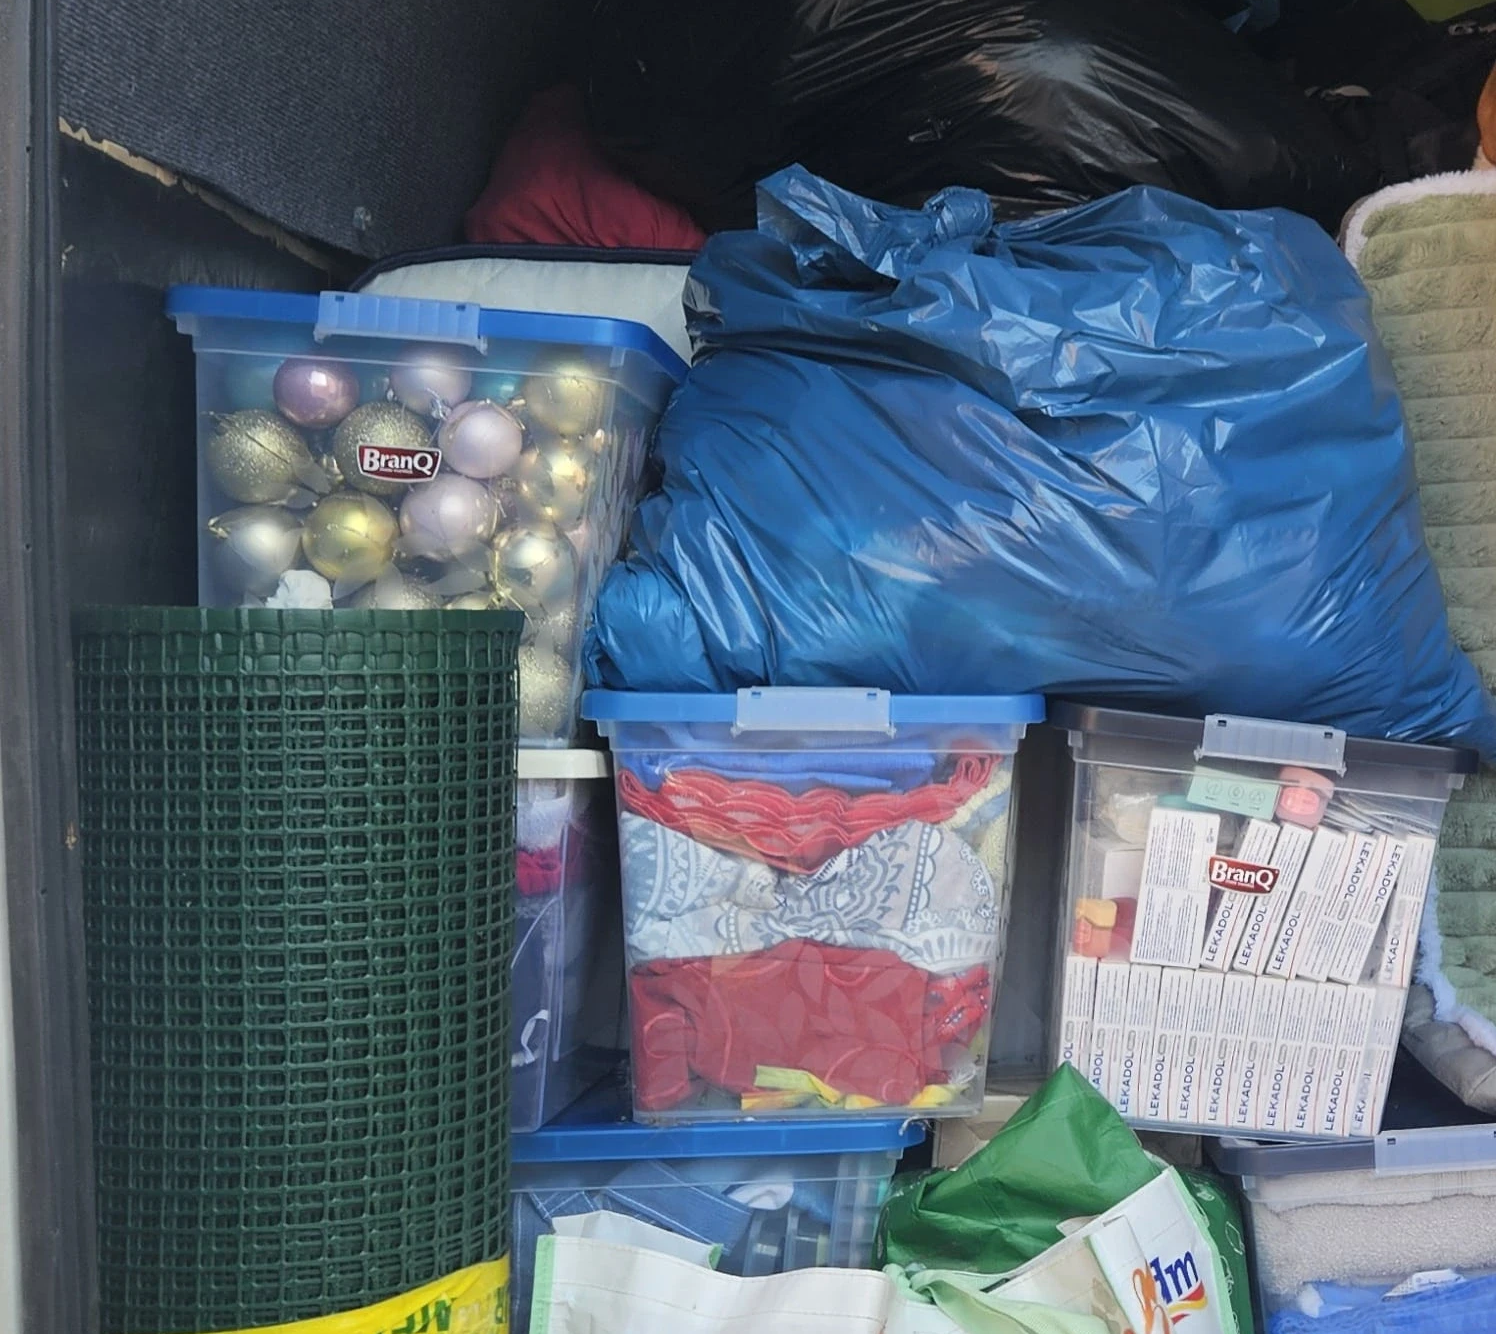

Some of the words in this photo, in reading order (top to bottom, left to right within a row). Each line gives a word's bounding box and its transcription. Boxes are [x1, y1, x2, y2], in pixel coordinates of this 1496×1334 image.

[363, 448, 432, 475] BranQ
[1211, 860, 1273, 892] BranQ
[1344, 841, 1373, 903] LEKADOL
[1375, 844, 1404, 905] LEKADOL
[1205, 902, 1235, 962] LEKADOL
[1239, 905, 1268, 966] LEKADOL
[1272, 910, 1301, 971] LEKADOL
[1120, 1050, 1135, 1114] LEKADOL
[1149, 1053, 1166, 1117] LEKADOL
[1178, 1057, 1196, 1119] LEKADOL
[1207, 1058, 1227, 1121] LEKADOL
[1237, 1060, 1256, 1124] LEKADOL
[1266, 1063, 1286, 1126] LEKADOL
[1295, 1066, 1315, 1129] LEKADOL
[1324, 1069, 1345, 1131] LEKADOL
